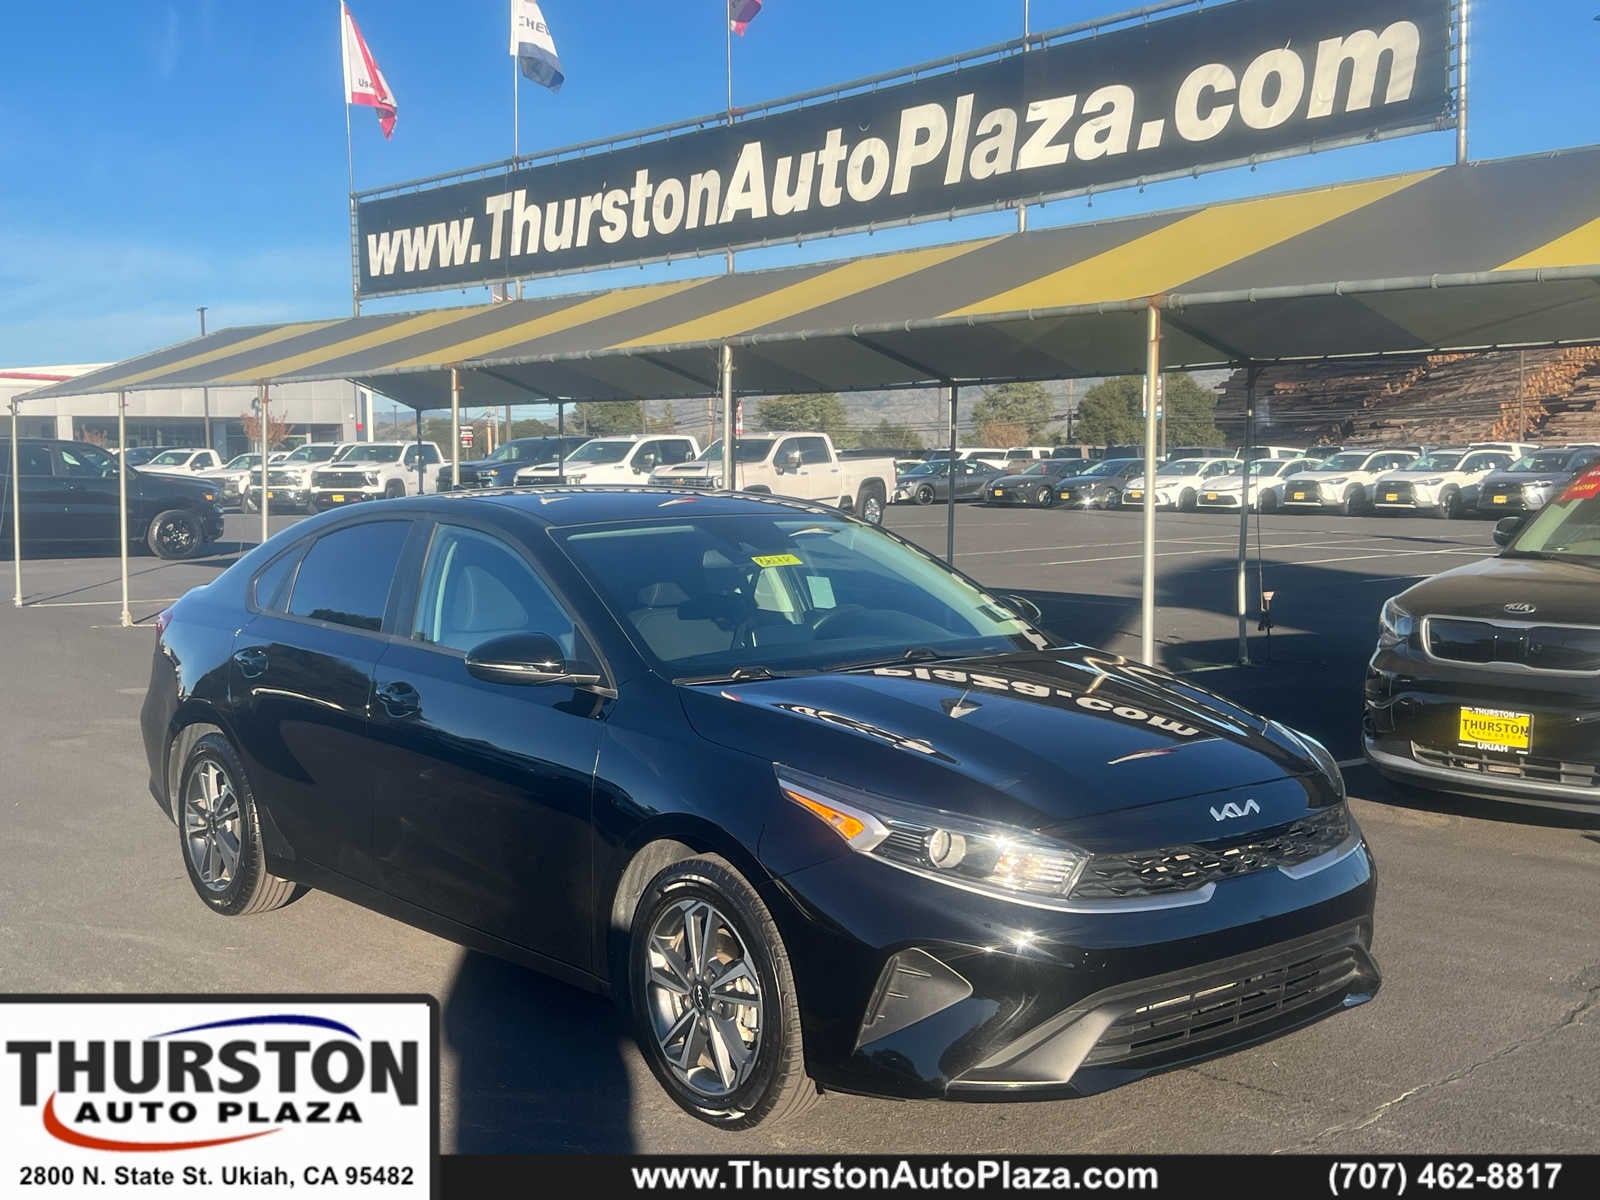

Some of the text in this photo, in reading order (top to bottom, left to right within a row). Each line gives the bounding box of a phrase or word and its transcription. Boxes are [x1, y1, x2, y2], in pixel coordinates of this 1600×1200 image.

[366, 20, 1421, 278] www.ThurstonAutoPlaza.com
[1473, 707, 1516, 718] THURSTON
[1462, 719, 1529, 738] THURSTON
[1477, 742, 1509, 752] UKIAH
[1209, 798, 1261, 821] KIA
